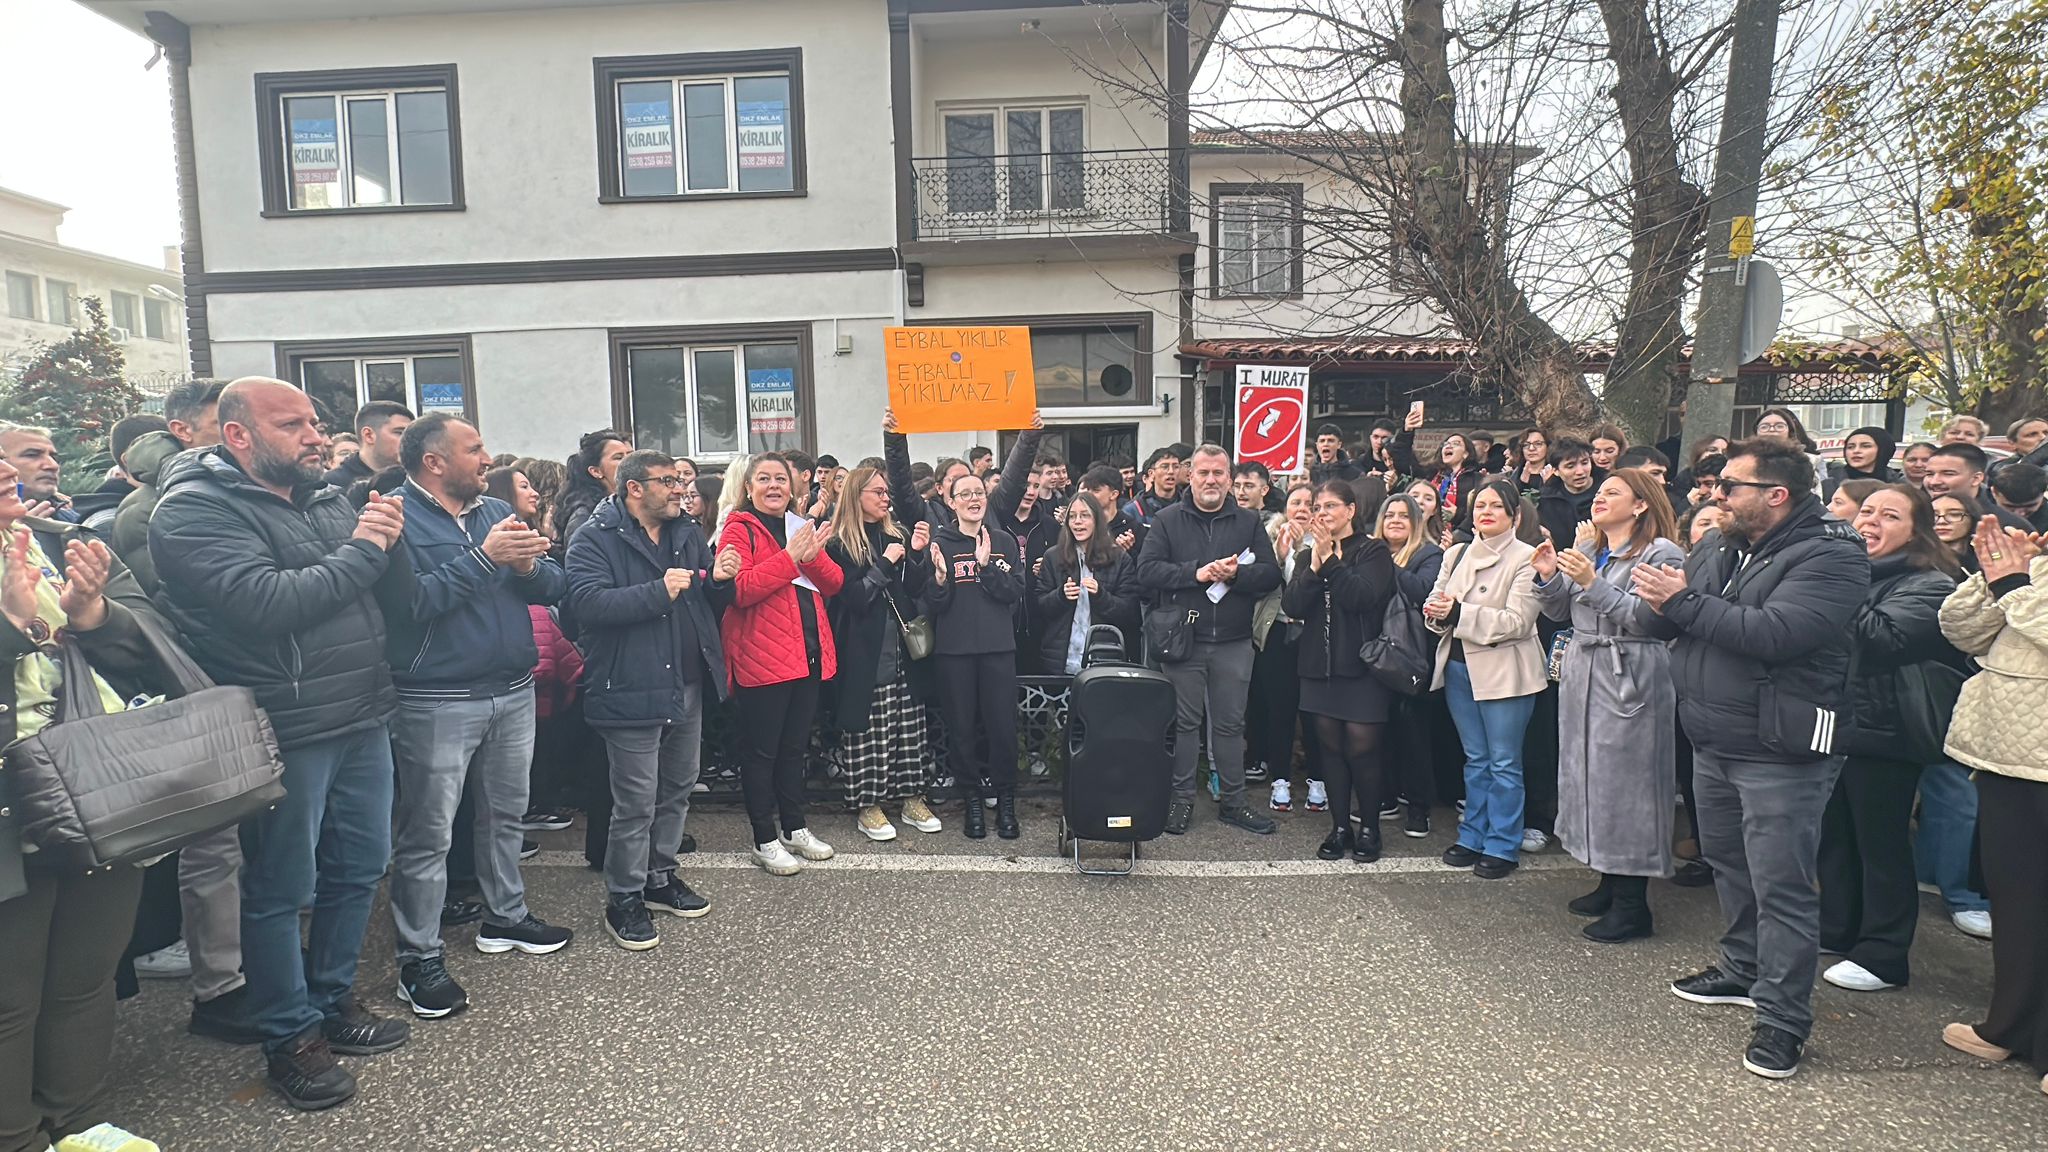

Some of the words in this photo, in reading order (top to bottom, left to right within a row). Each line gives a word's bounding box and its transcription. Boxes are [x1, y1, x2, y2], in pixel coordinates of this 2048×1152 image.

[627, 131, 670, 148] KİRALIK
[740, 130, 783, 147] KİRALIK
[295, 147, 336, 163] KİRALIK
[776, 155, 784, 165] 22
[894, 331, 952, 349] EYBAL
[957, 329, 1011, 349] YIKILIR
[898, 362, 974, 382] EYBALLI
[1261, 371, 1308, 387] MURAT
[899, 382, 998, 404] YIKILMAZ
[751, 396, 793, 412] KİRALIK
[787, 420, 795, 430] 22
